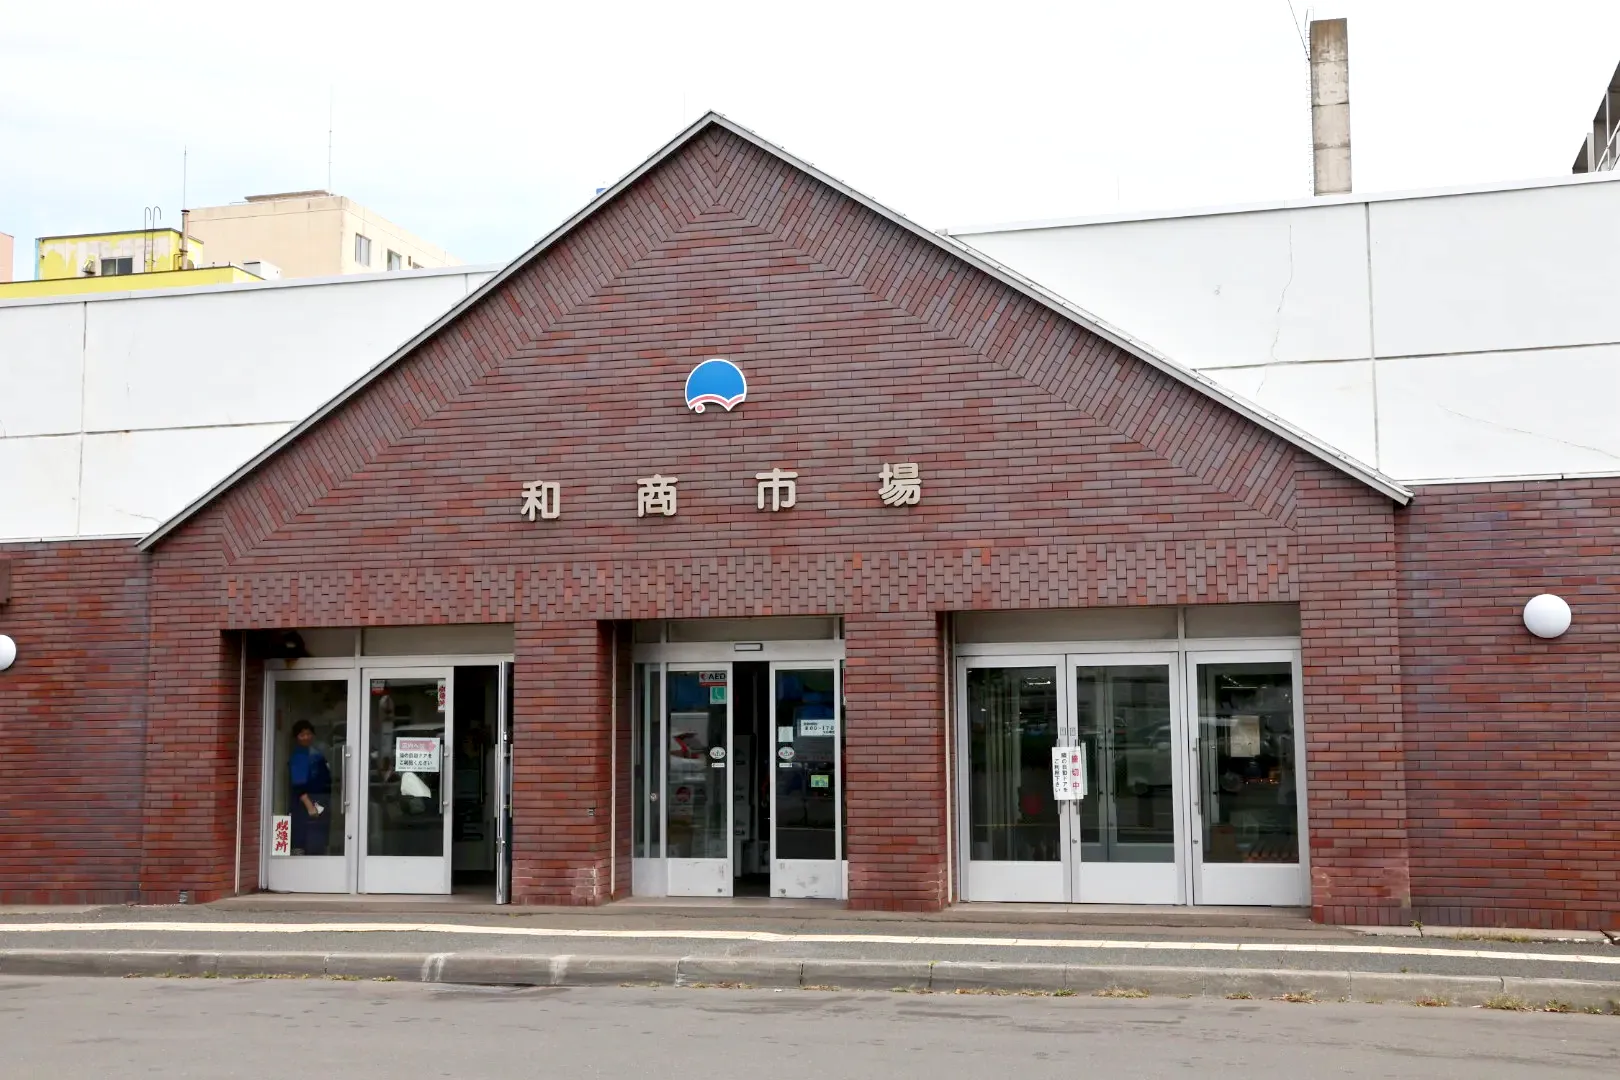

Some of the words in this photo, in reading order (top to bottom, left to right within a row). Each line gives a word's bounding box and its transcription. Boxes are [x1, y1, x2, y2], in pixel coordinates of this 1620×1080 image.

[520, 462, 922, 522] 和商市場
[708, 672, 726, 680] AED
